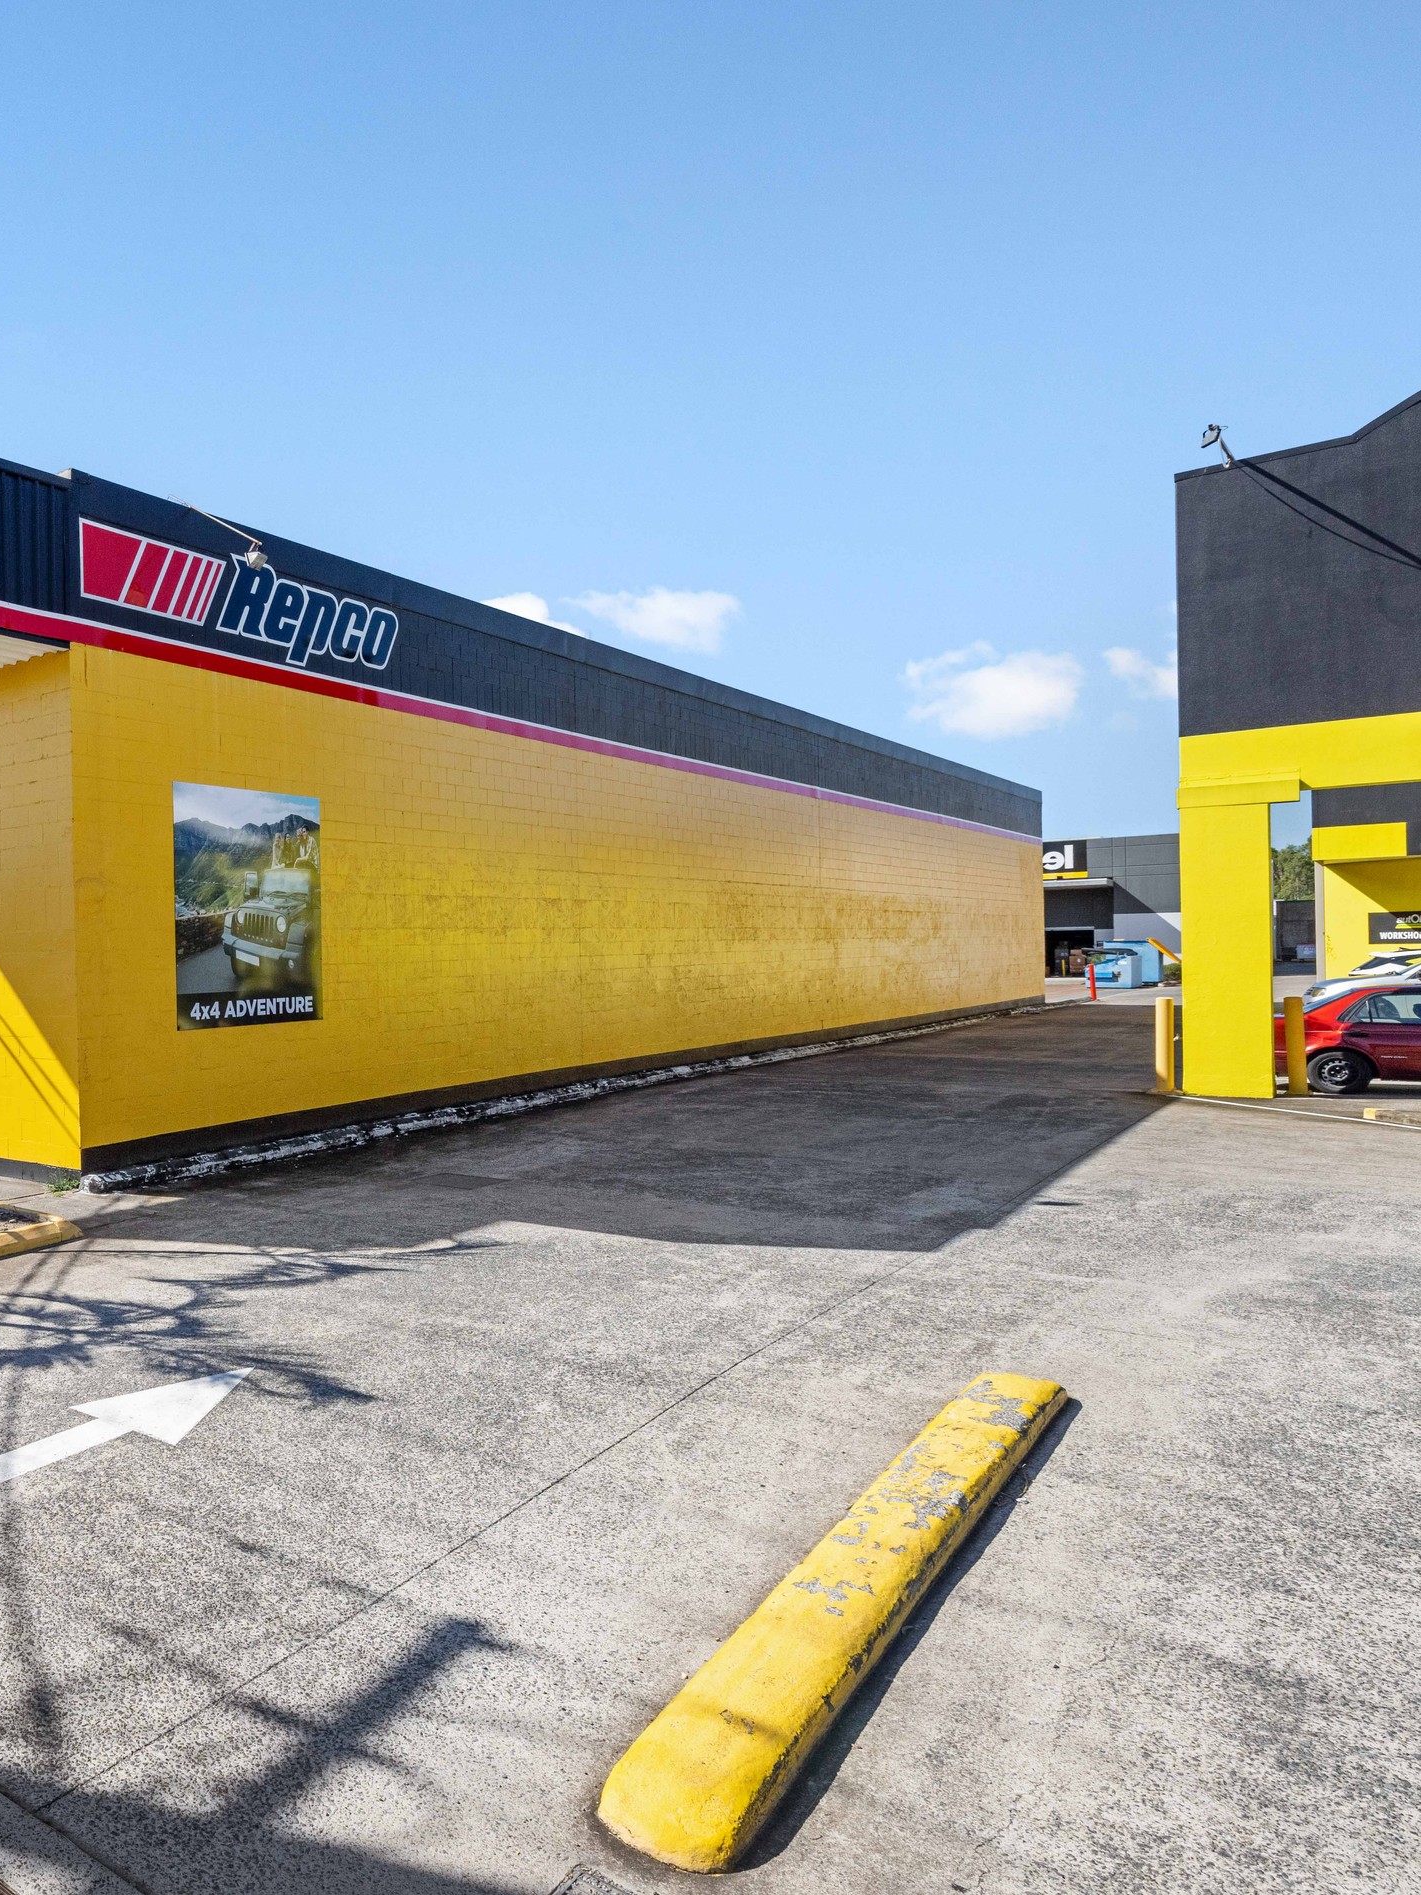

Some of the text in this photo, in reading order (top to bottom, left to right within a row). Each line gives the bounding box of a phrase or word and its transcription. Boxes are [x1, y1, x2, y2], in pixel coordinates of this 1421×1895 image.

[215, 552, 399, 671] Repco
[190, 995, 314, 1020] 4x4 ADVENTURE
